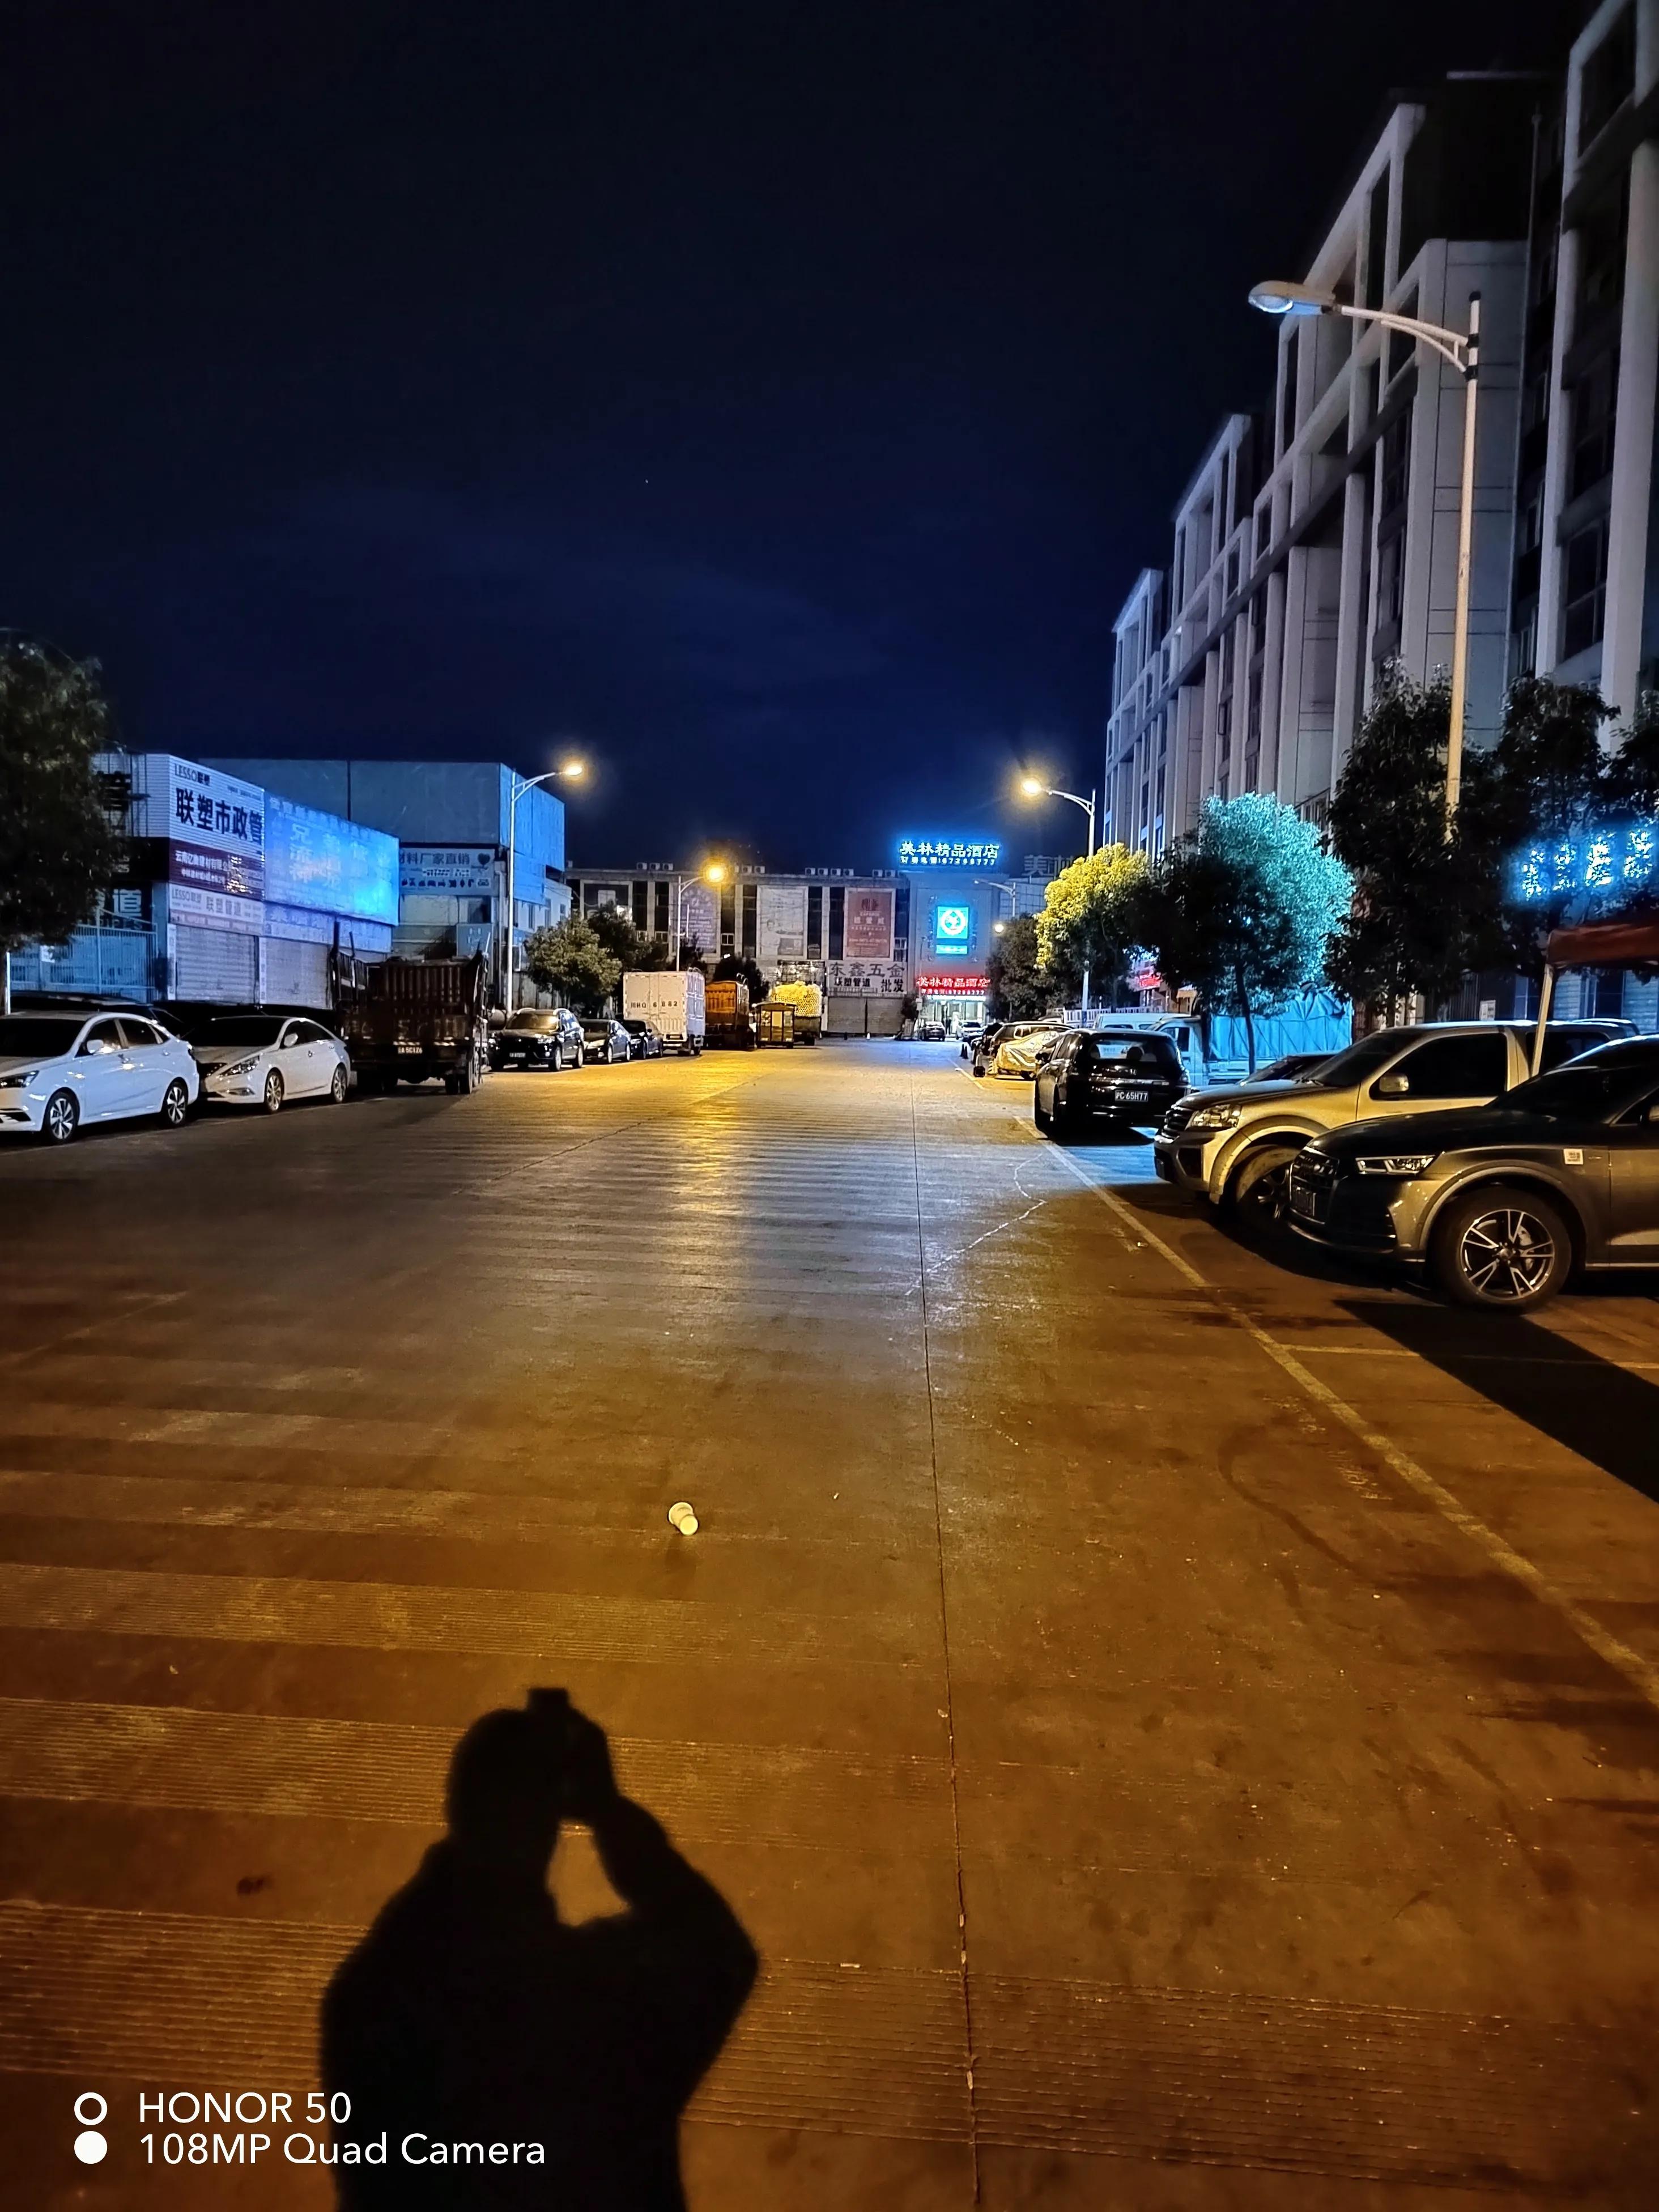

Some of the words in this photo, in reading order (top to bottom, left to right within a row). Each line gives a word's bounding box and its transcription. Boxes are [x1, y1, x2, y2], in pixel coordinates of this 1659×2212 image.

[176, 788, 262, 845] 联塑市政管
[829, 962, 905, 978] 东鑫五金
[880, 978, 904, 993] 批发
